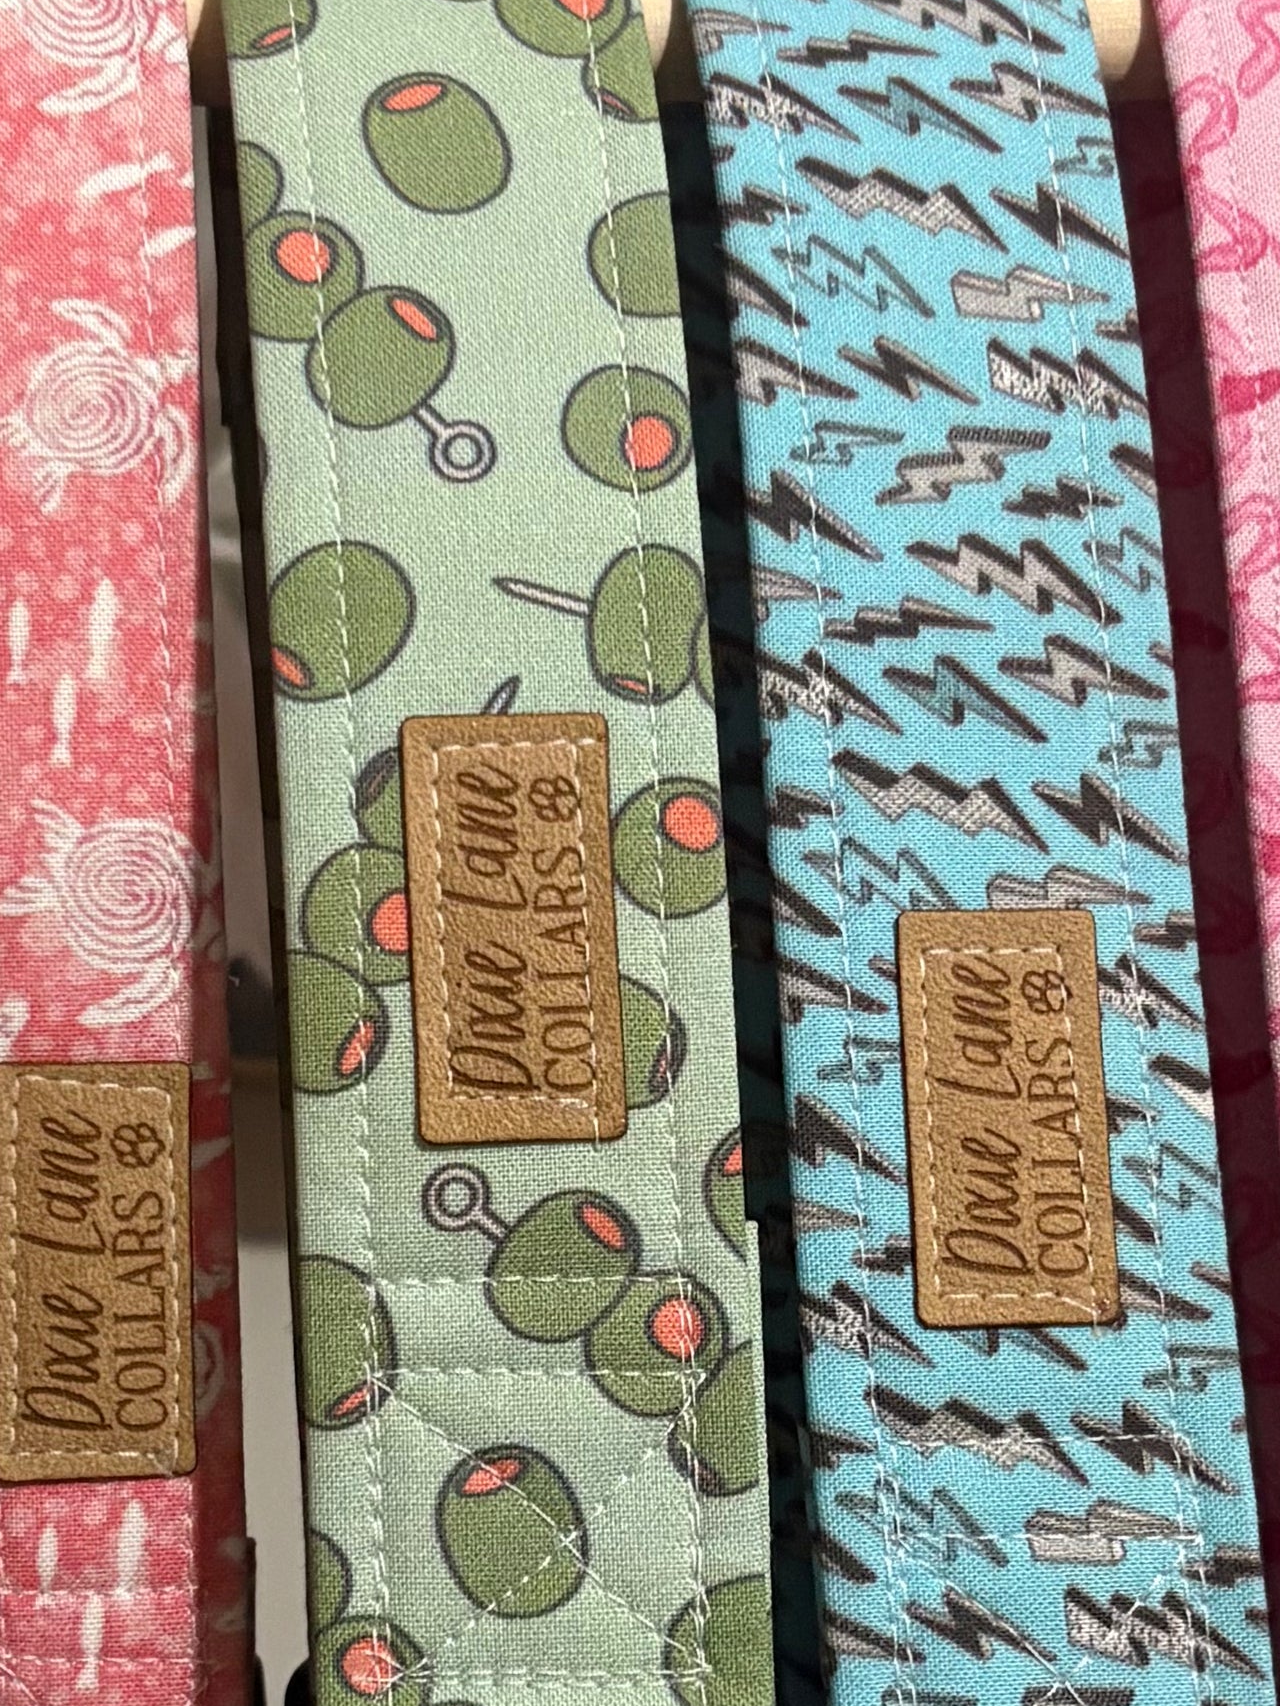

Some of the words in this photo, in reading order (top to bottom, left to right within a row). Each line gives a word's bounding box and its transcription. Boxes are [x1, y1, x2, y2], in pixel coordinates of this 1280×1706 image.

[442, 764, 528, 912] Lane
[532, 848, 597, 1091] COLLARS
[934, 956, 1021, 1100] Lane
[19, 1109, 108, 1255] Lane
[1026, 1038, 1088, 1278] COLLARS
[111, 1191, 169, 1433] COLLARS
